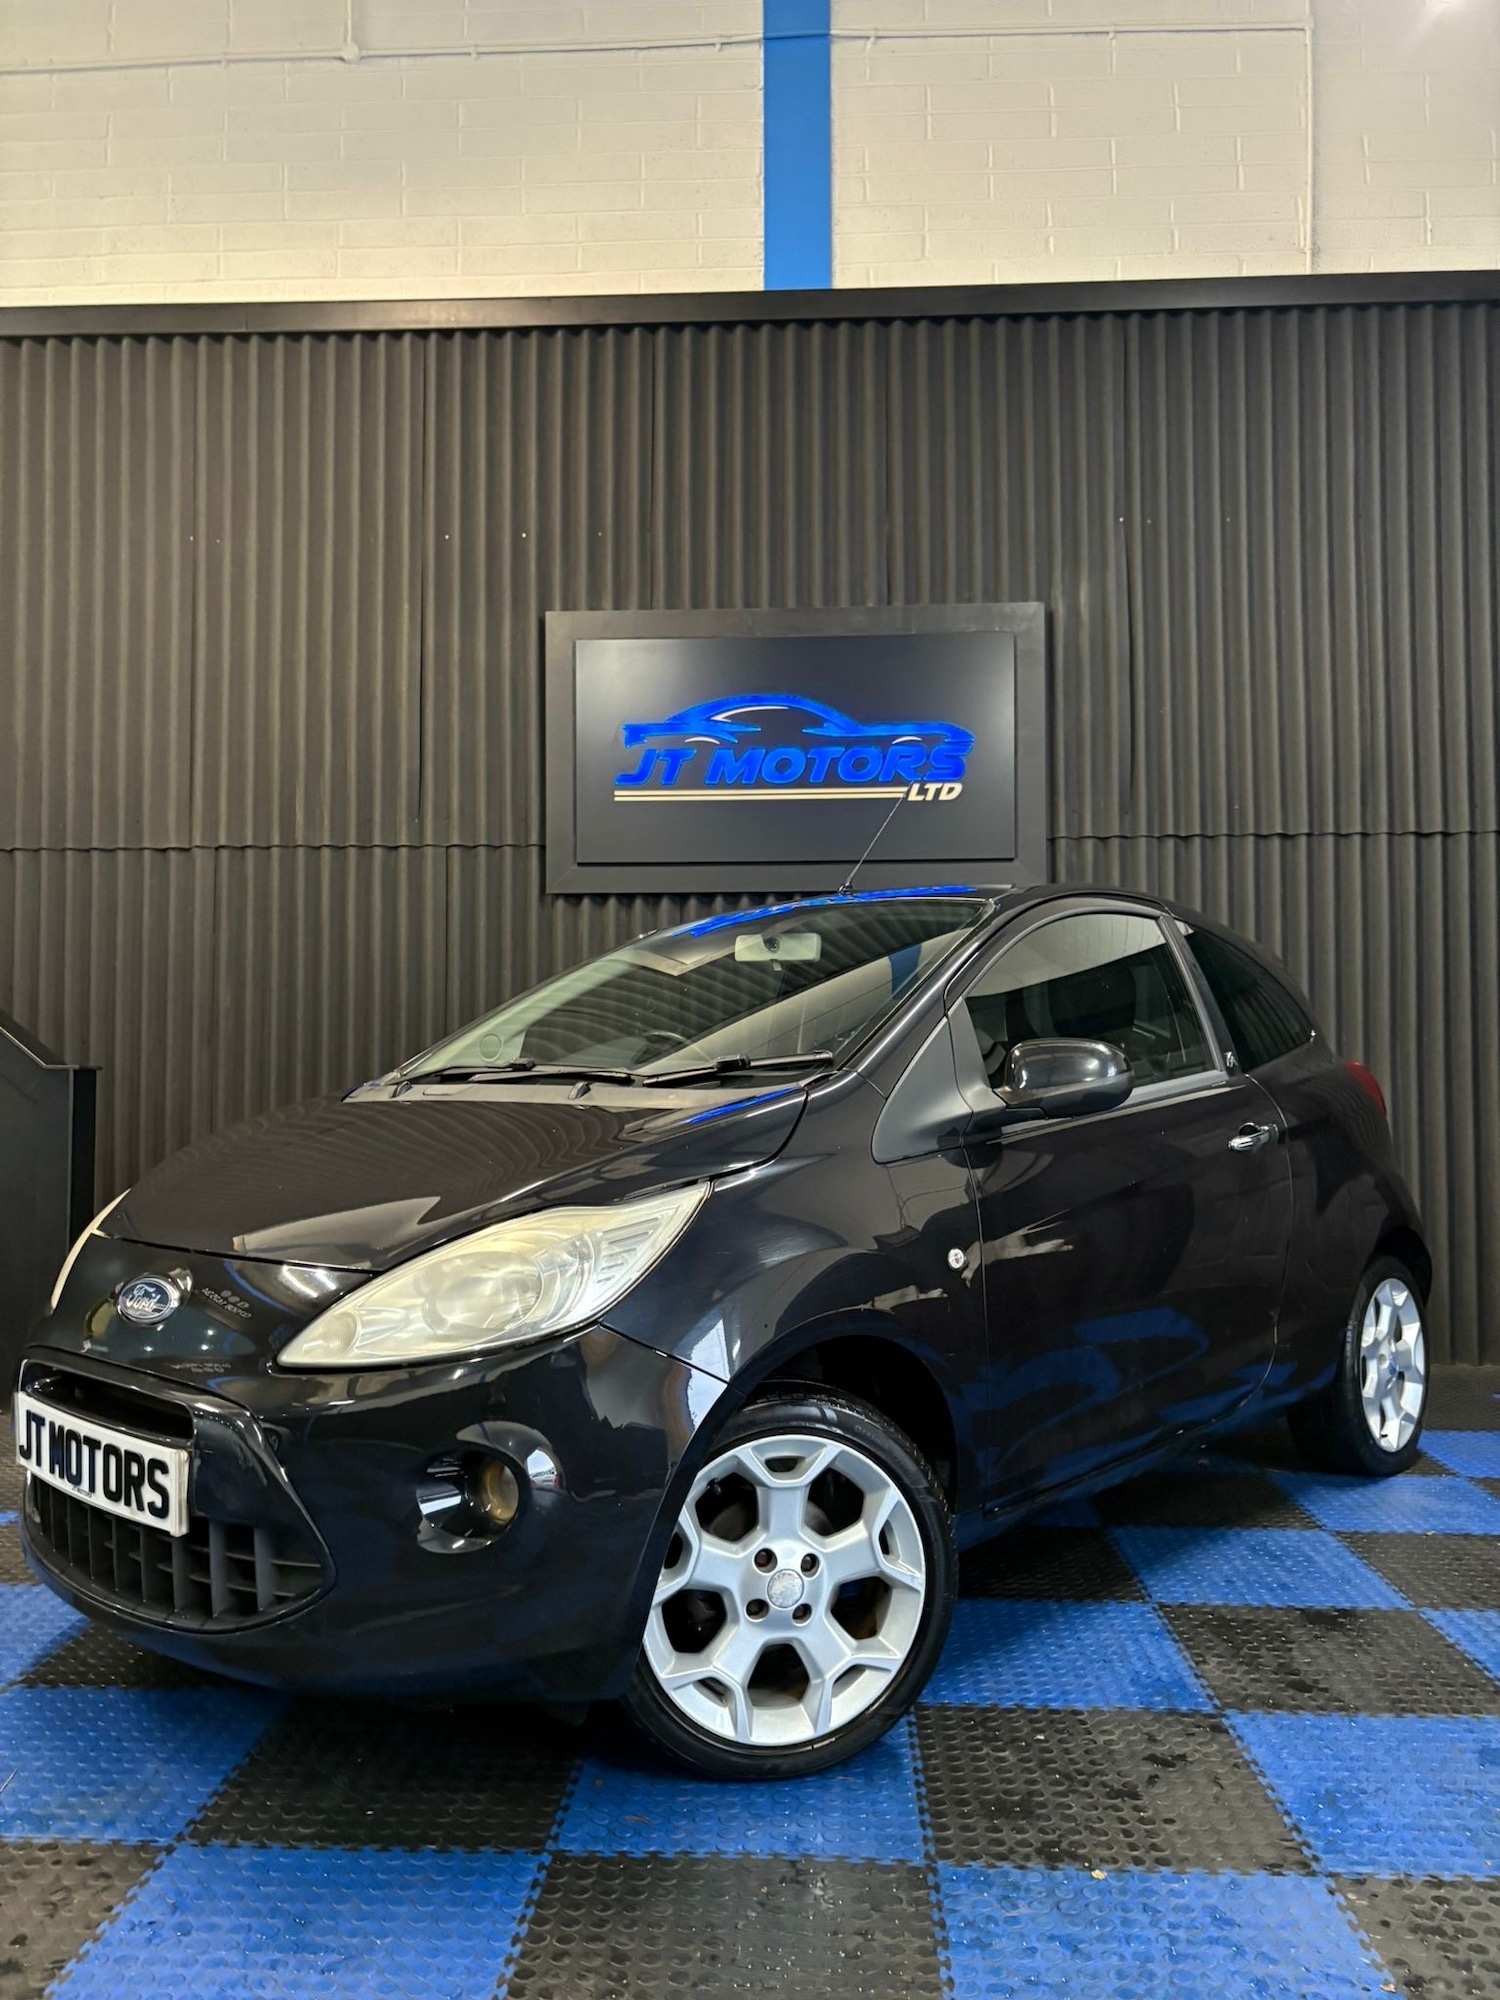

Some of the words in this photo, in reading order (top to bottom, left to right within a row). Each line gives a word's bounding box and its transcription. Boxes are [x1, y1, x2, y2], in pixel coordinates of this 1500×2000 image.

[614, 749, 697, 786] JT
[704, 743, 973, 785] MOTORS
[906, 782, 962, 801] LTD
[125, 1283, 164, 1311] Ford
[19, 1409, 45, 1468] JT
[48, 1420, 170, 1519] MOTORS
